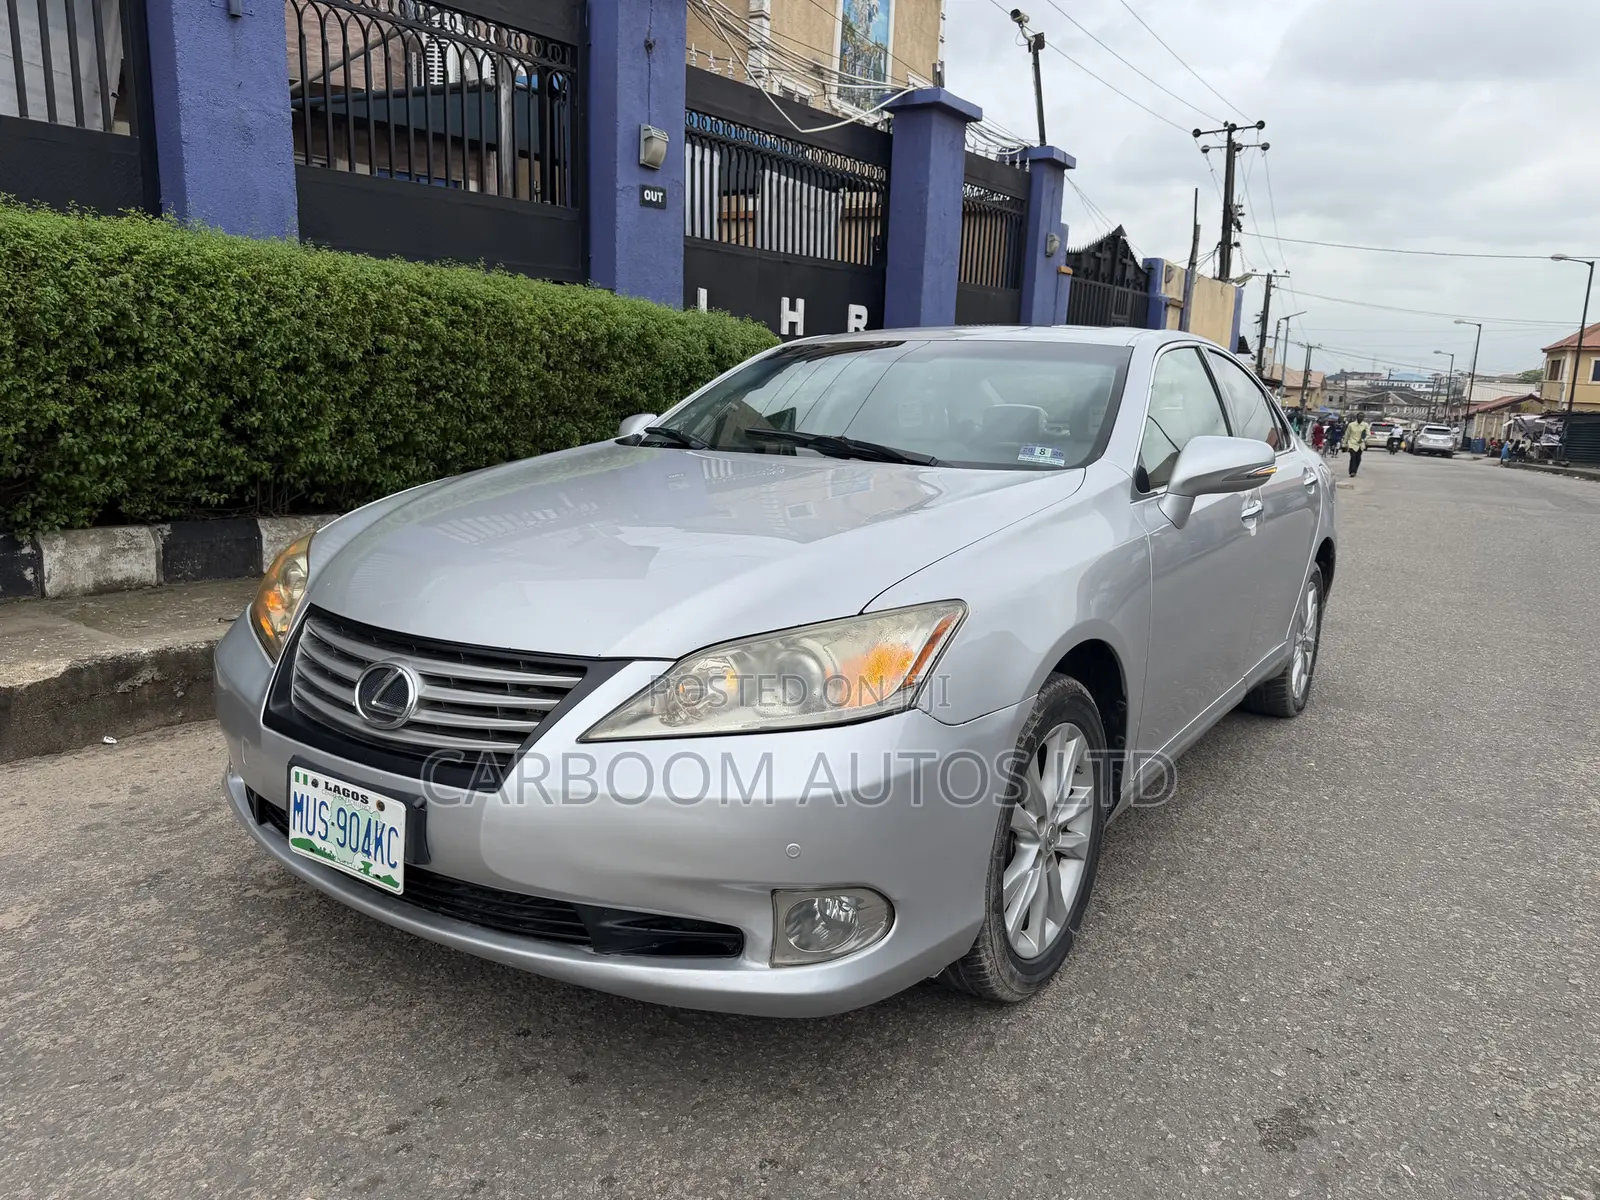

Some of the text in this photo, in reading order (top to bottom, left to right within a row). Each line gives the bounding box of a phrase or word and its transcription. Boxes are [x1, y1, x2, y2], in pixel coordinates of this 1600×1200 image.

[643, 189, 664, 203] OUT
[1039, 447, 1046, 456] 8
[324, 780, 370, 805] LAGOS
